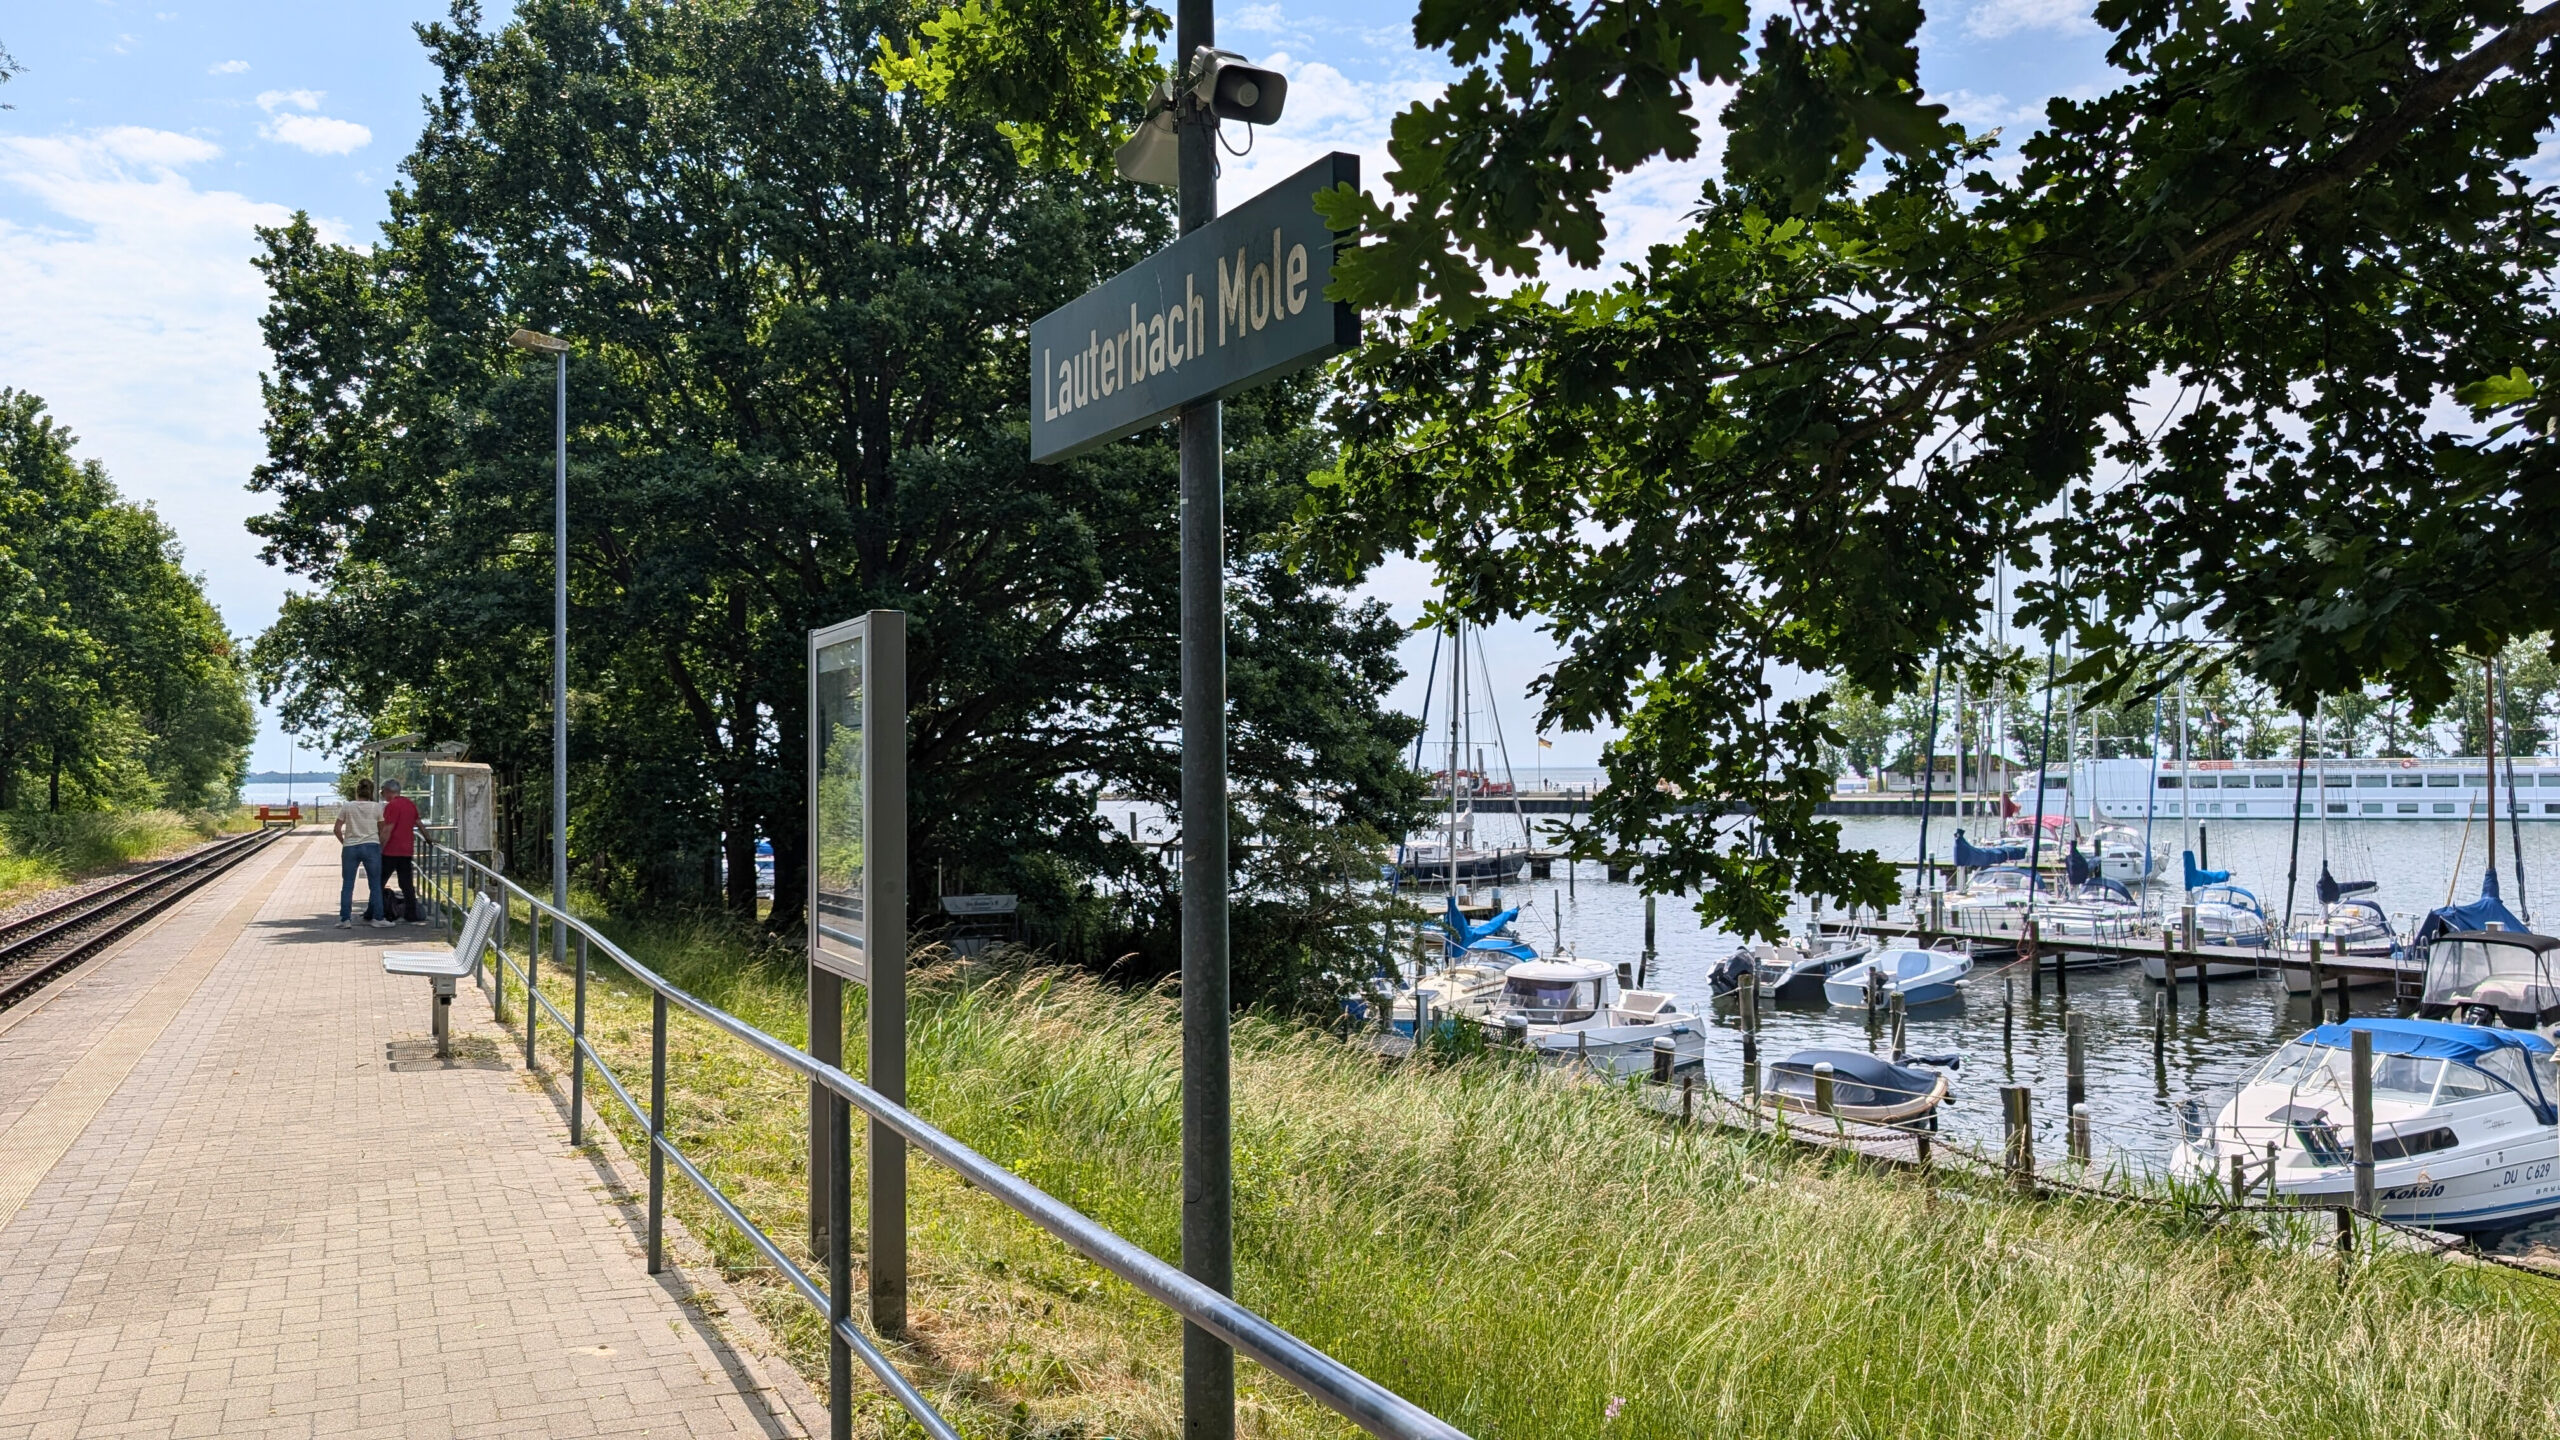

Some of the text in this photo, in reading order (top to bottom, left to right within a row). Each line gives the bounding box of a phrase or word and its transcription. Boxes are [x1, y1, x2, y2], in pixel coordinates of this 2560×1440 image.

[1044, 227, 1308, 422] Lauterbach Mole
[2503, 1169, 2519, 1185] DU
[2380, 1183, 2444, 1200] Kokolo
